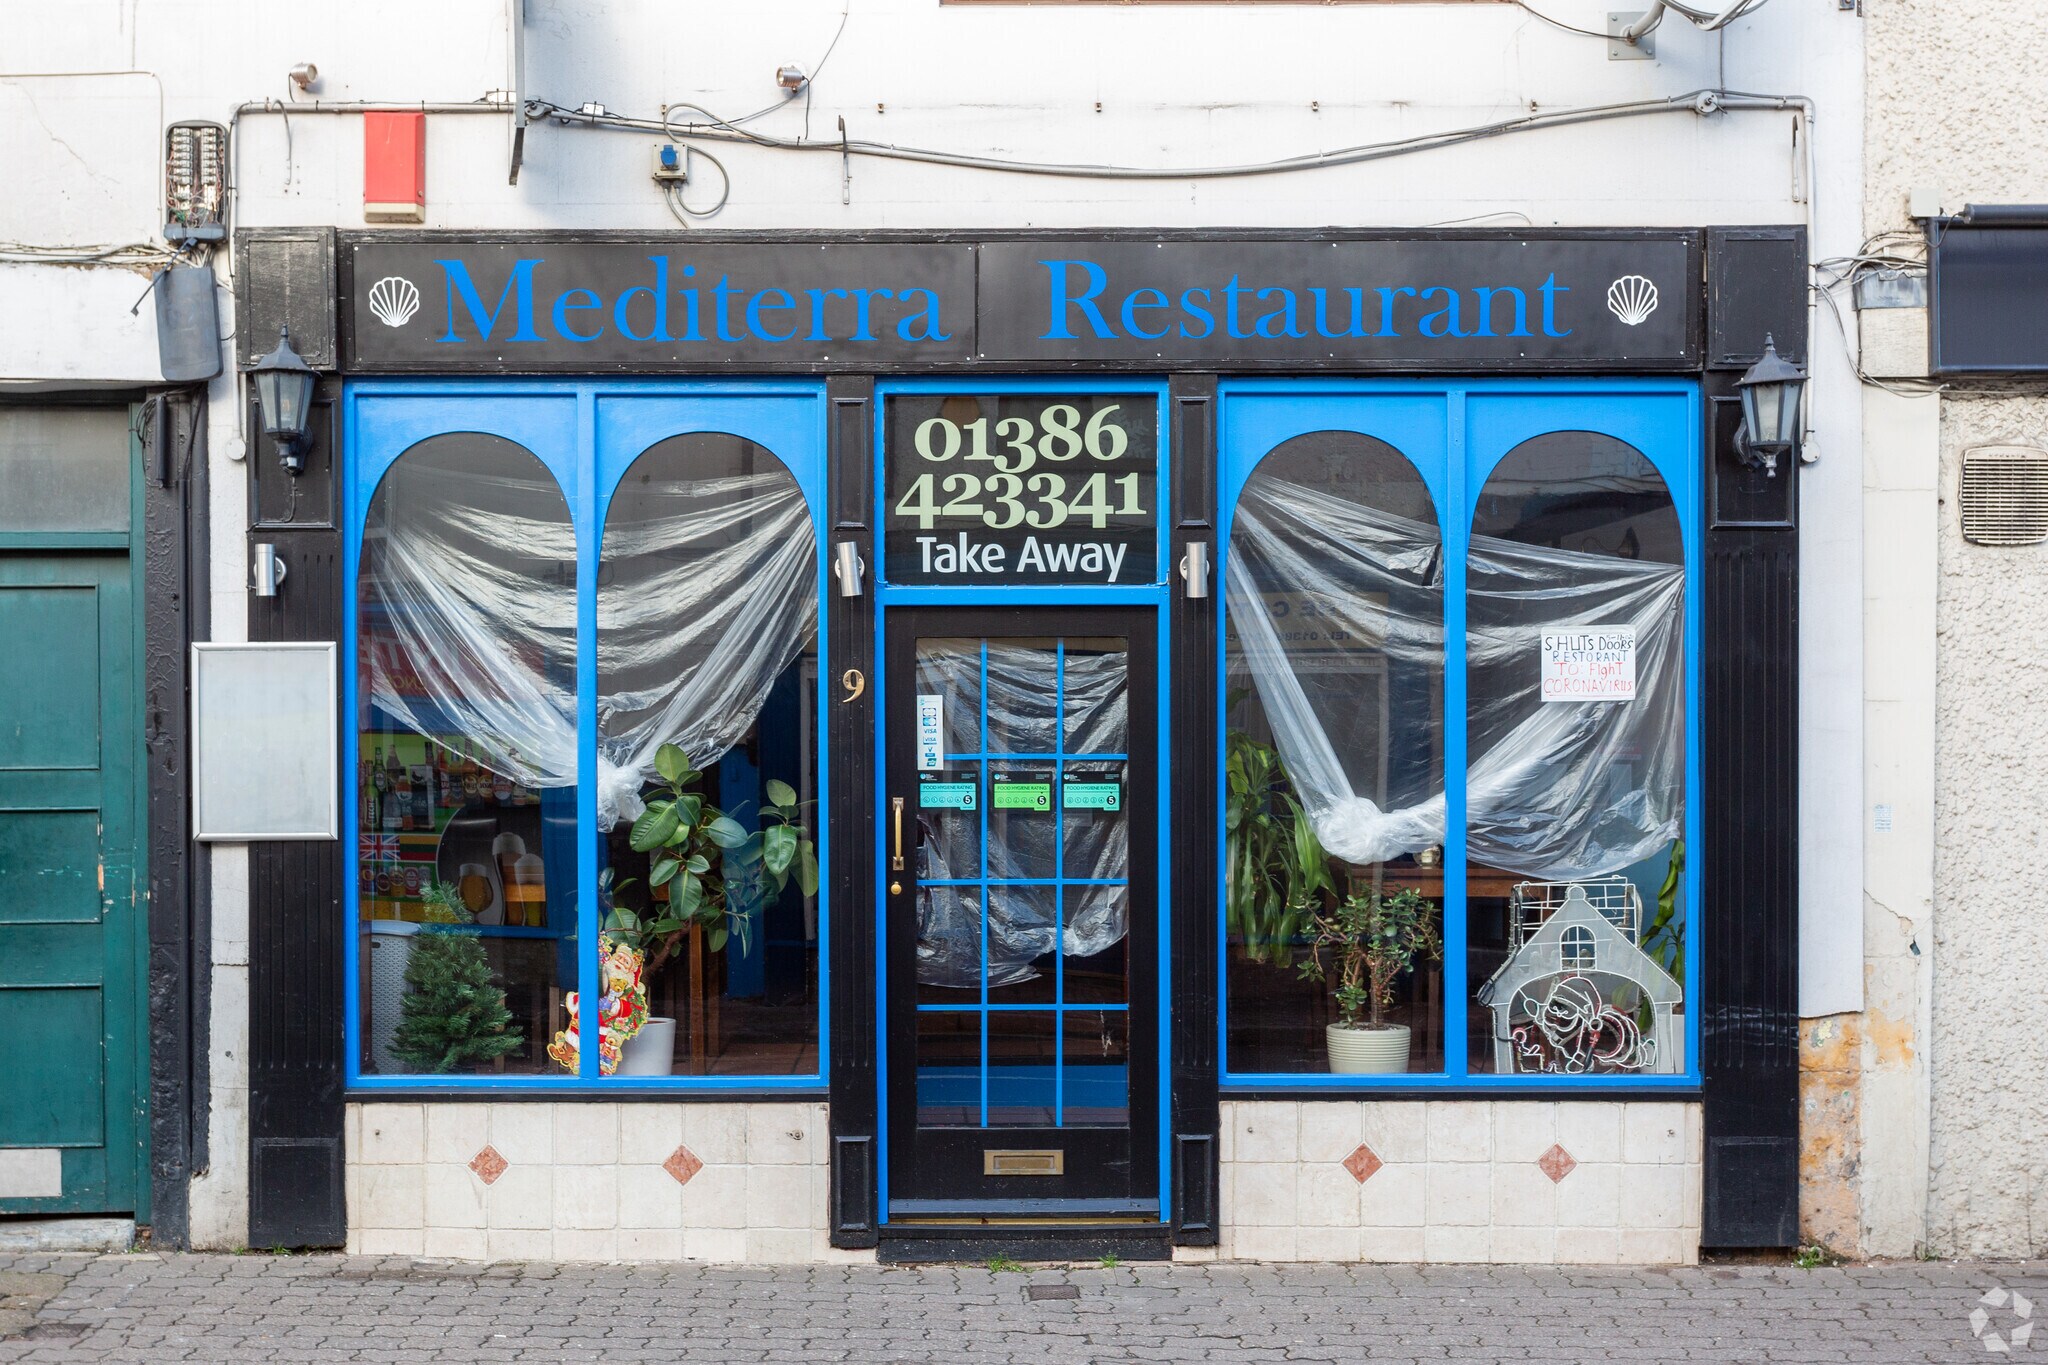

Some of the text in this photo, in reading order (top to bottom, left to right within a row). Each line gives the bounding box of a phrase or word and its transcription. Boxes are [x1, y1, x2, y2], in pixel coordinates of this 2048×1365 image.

[434, 256, 1572, 343] Mediterra Restaurant
[914, 404, 1128, 473] 01386
[895, 472, 1147, 530] 423341
[916, 532, 1128, 583] Take Away
[1552, 650, 1629, 662] RESTORANT
[842, 669, 865, 703] 9
[1543, 678, 1633, 693] CORONAVIRUS
[964, 795, 971, 804] 5
[1039, 796, 1045, 804] 5
[1108, 796, 1114, 804] 5
